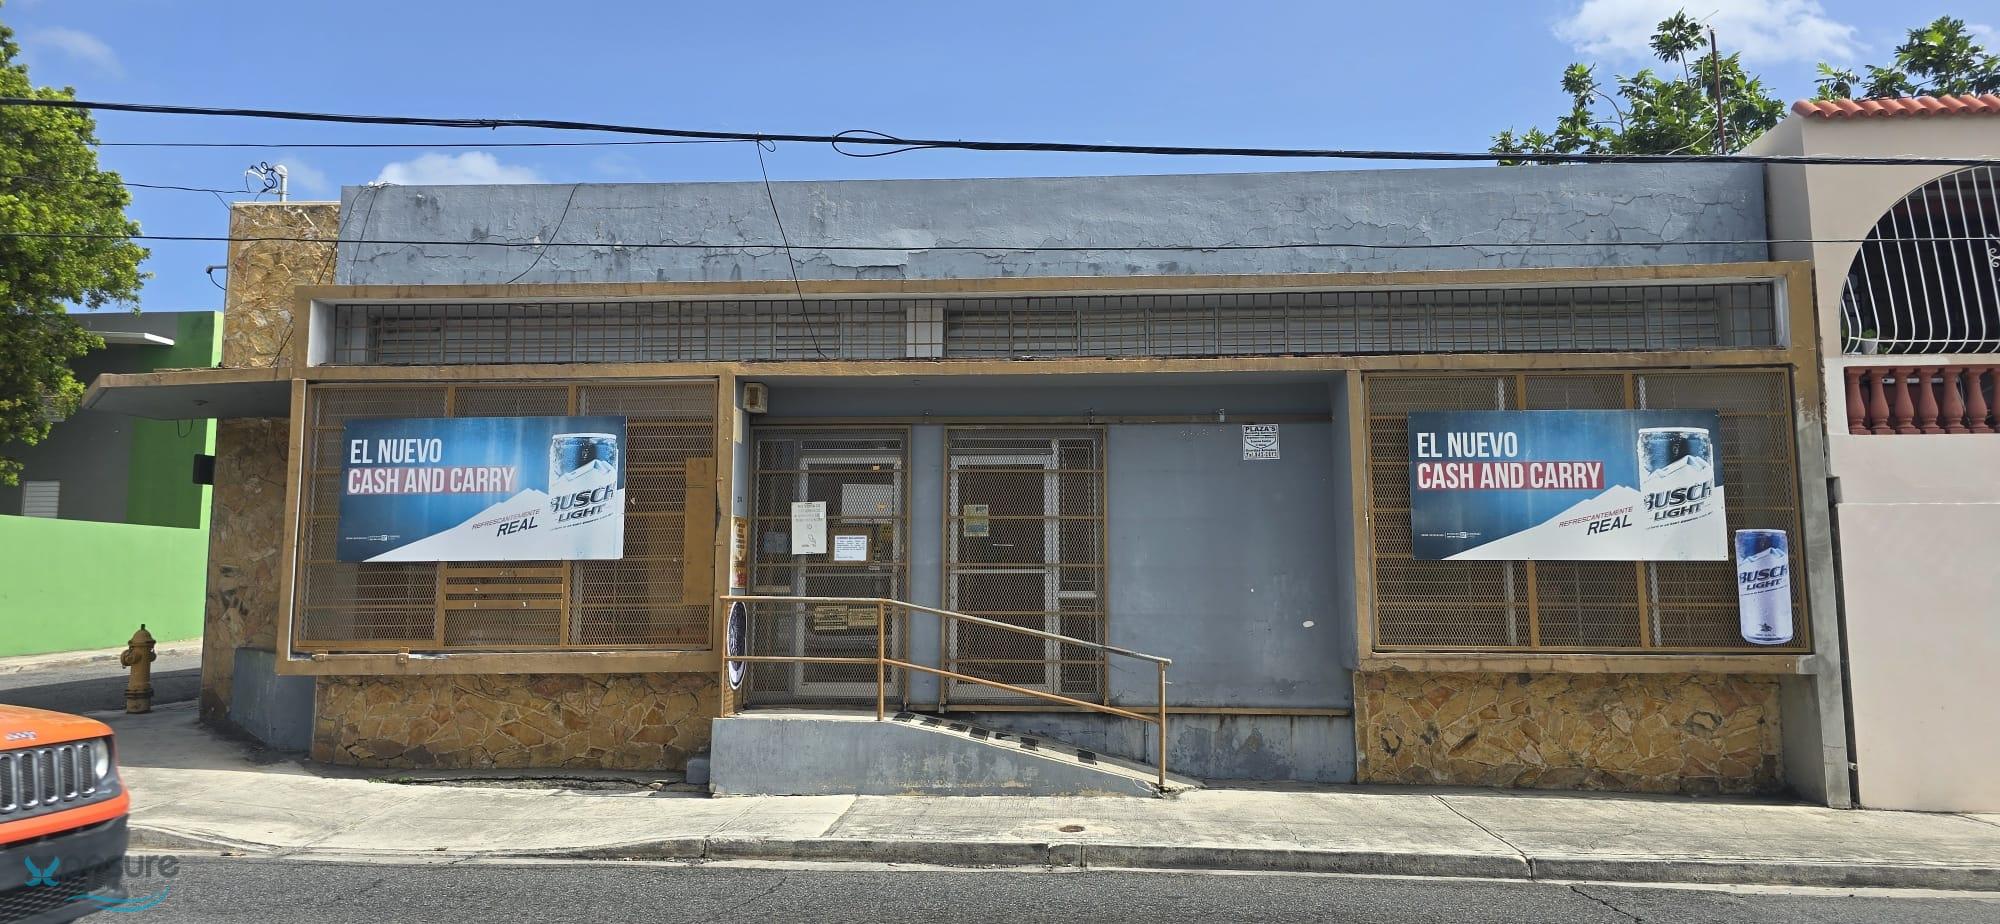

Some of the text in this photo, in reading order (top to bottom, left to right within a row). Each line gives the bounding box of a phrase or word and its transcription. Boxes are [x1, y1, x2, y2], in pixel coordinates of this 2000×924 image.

[350, 438, 443, 464] EL NUEVO
[1417, 431, 1518, 458] EL NUEVO
[348, 467, 515, 494] CASH AND CARRY
[1417, 462, 1601, 489] CASH AND CARRY
[471, 508, 541, 530] REFRESCANTEMENTE
[558, 503, 604, 522] LIGHT
[1558, 506, 1634, 528] REFRESCANTEMENTE
[1653, 501, 1704, 521] LIGHT
[496, 516, 538, 537] REAL
[1587, 514, 1633, 536] REAL
[1746, 578, 1783, 591] LIGHT
